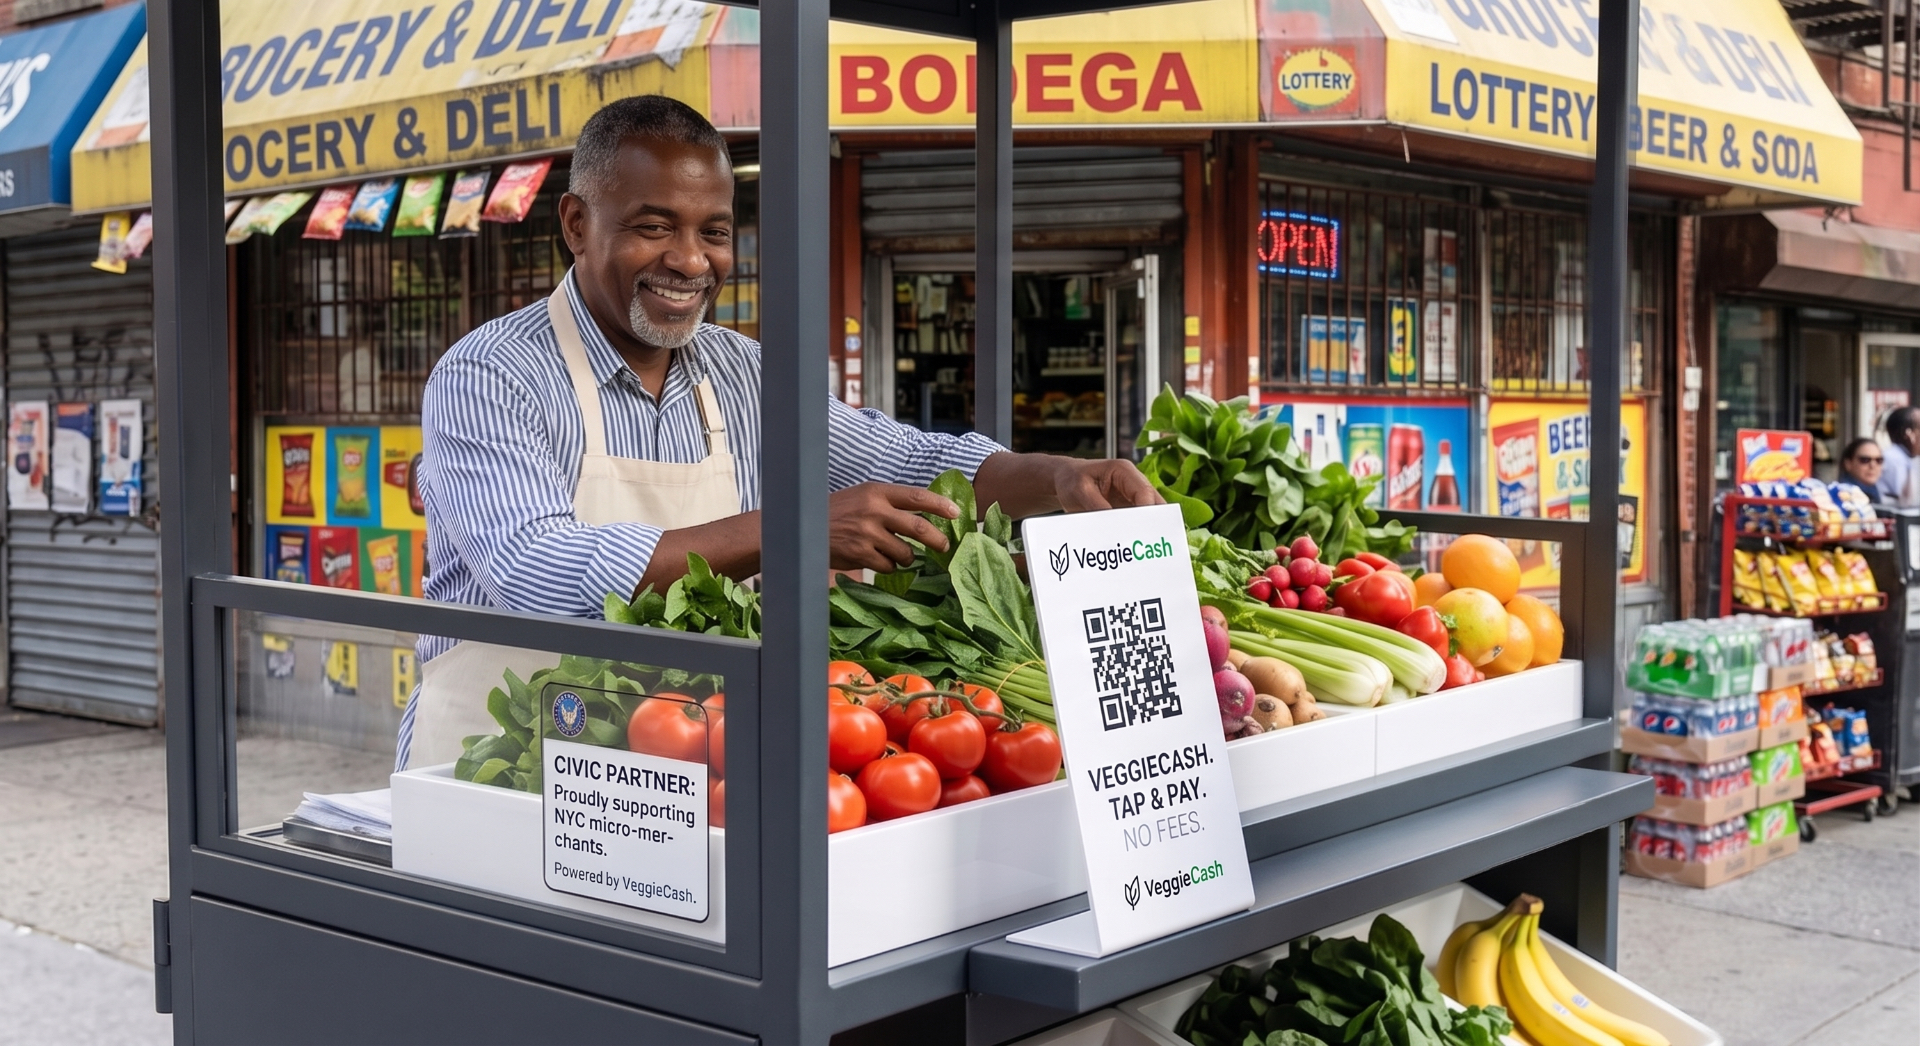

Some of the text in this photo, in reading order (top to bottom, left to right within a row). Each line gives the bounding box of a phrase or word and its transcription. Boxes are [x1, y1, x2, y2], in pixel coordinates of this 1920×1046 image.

[222, 6, 434, 105] ROCERY
[840, 52, 1204, 114] BOEGA
[1282, 72, 1352, 90] LOTTERY
[225, 82, 561, 183] OCERY & DELI
[1431, 62, 1819, 184] LOTTERY BEER & SODA
[1257, 220, 1337, 269] OPEN
[1549, 415, 1590, 454] BEE
[1073, 536, 1173, 571] VeggieCash
[554, 755, 696, 796] CIVIC PARTNER:
[1088, 743, 1214, 792] VEGGIECASH.
[554, 783, 696, 829] Proudly supporting
[1108, 776, 1207, 821] TAP & PAY.
[554, 807, 674, 844] NYC micro-mer-
[554, 833, 608, 857] chants.
[1123, 810, 1205, 852] NO FEES.
[554, 861, 697, 904] Powered by VeggieCash.
[1144, 859, 1224, 898] VeggieCash
